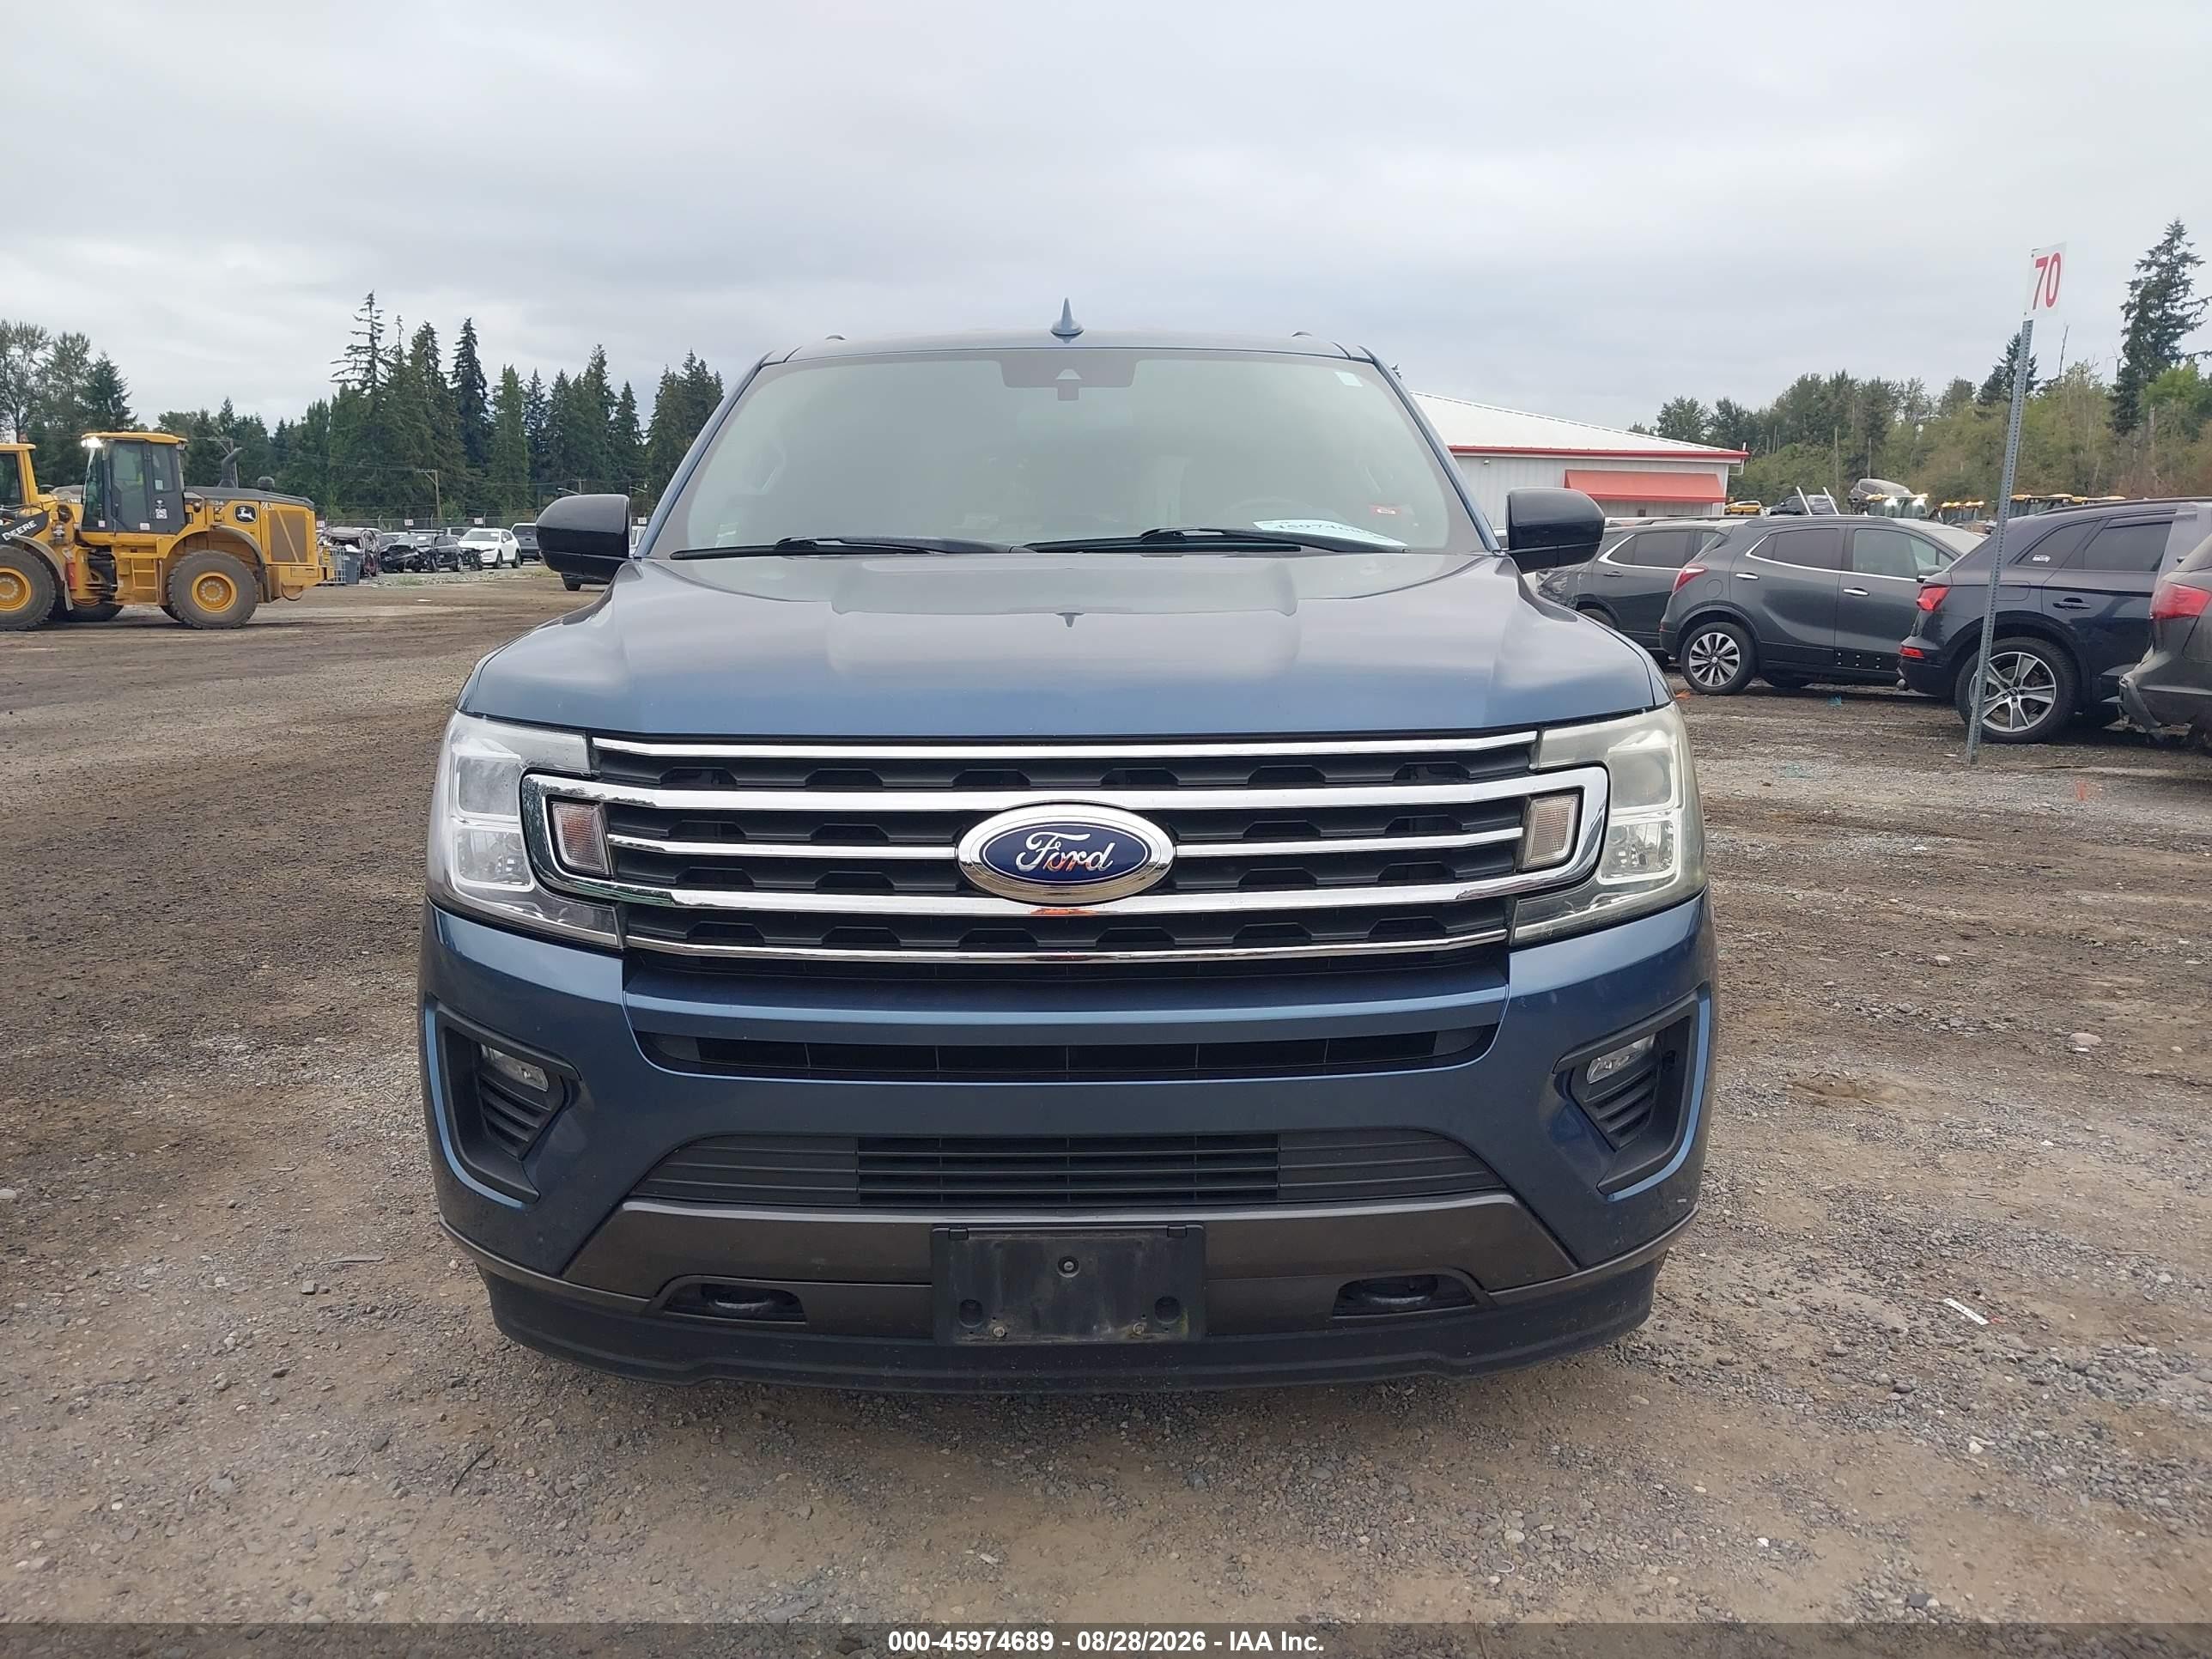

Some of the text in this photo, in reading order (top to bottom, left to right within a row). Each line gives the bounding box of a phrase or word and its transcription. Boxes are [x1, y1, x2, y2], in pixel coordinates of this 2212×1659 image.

[2032, 252, 2062, 311] 70
[2, 520, 37, 541] DEERE
[1015, 830, 1116, 872] Ford
